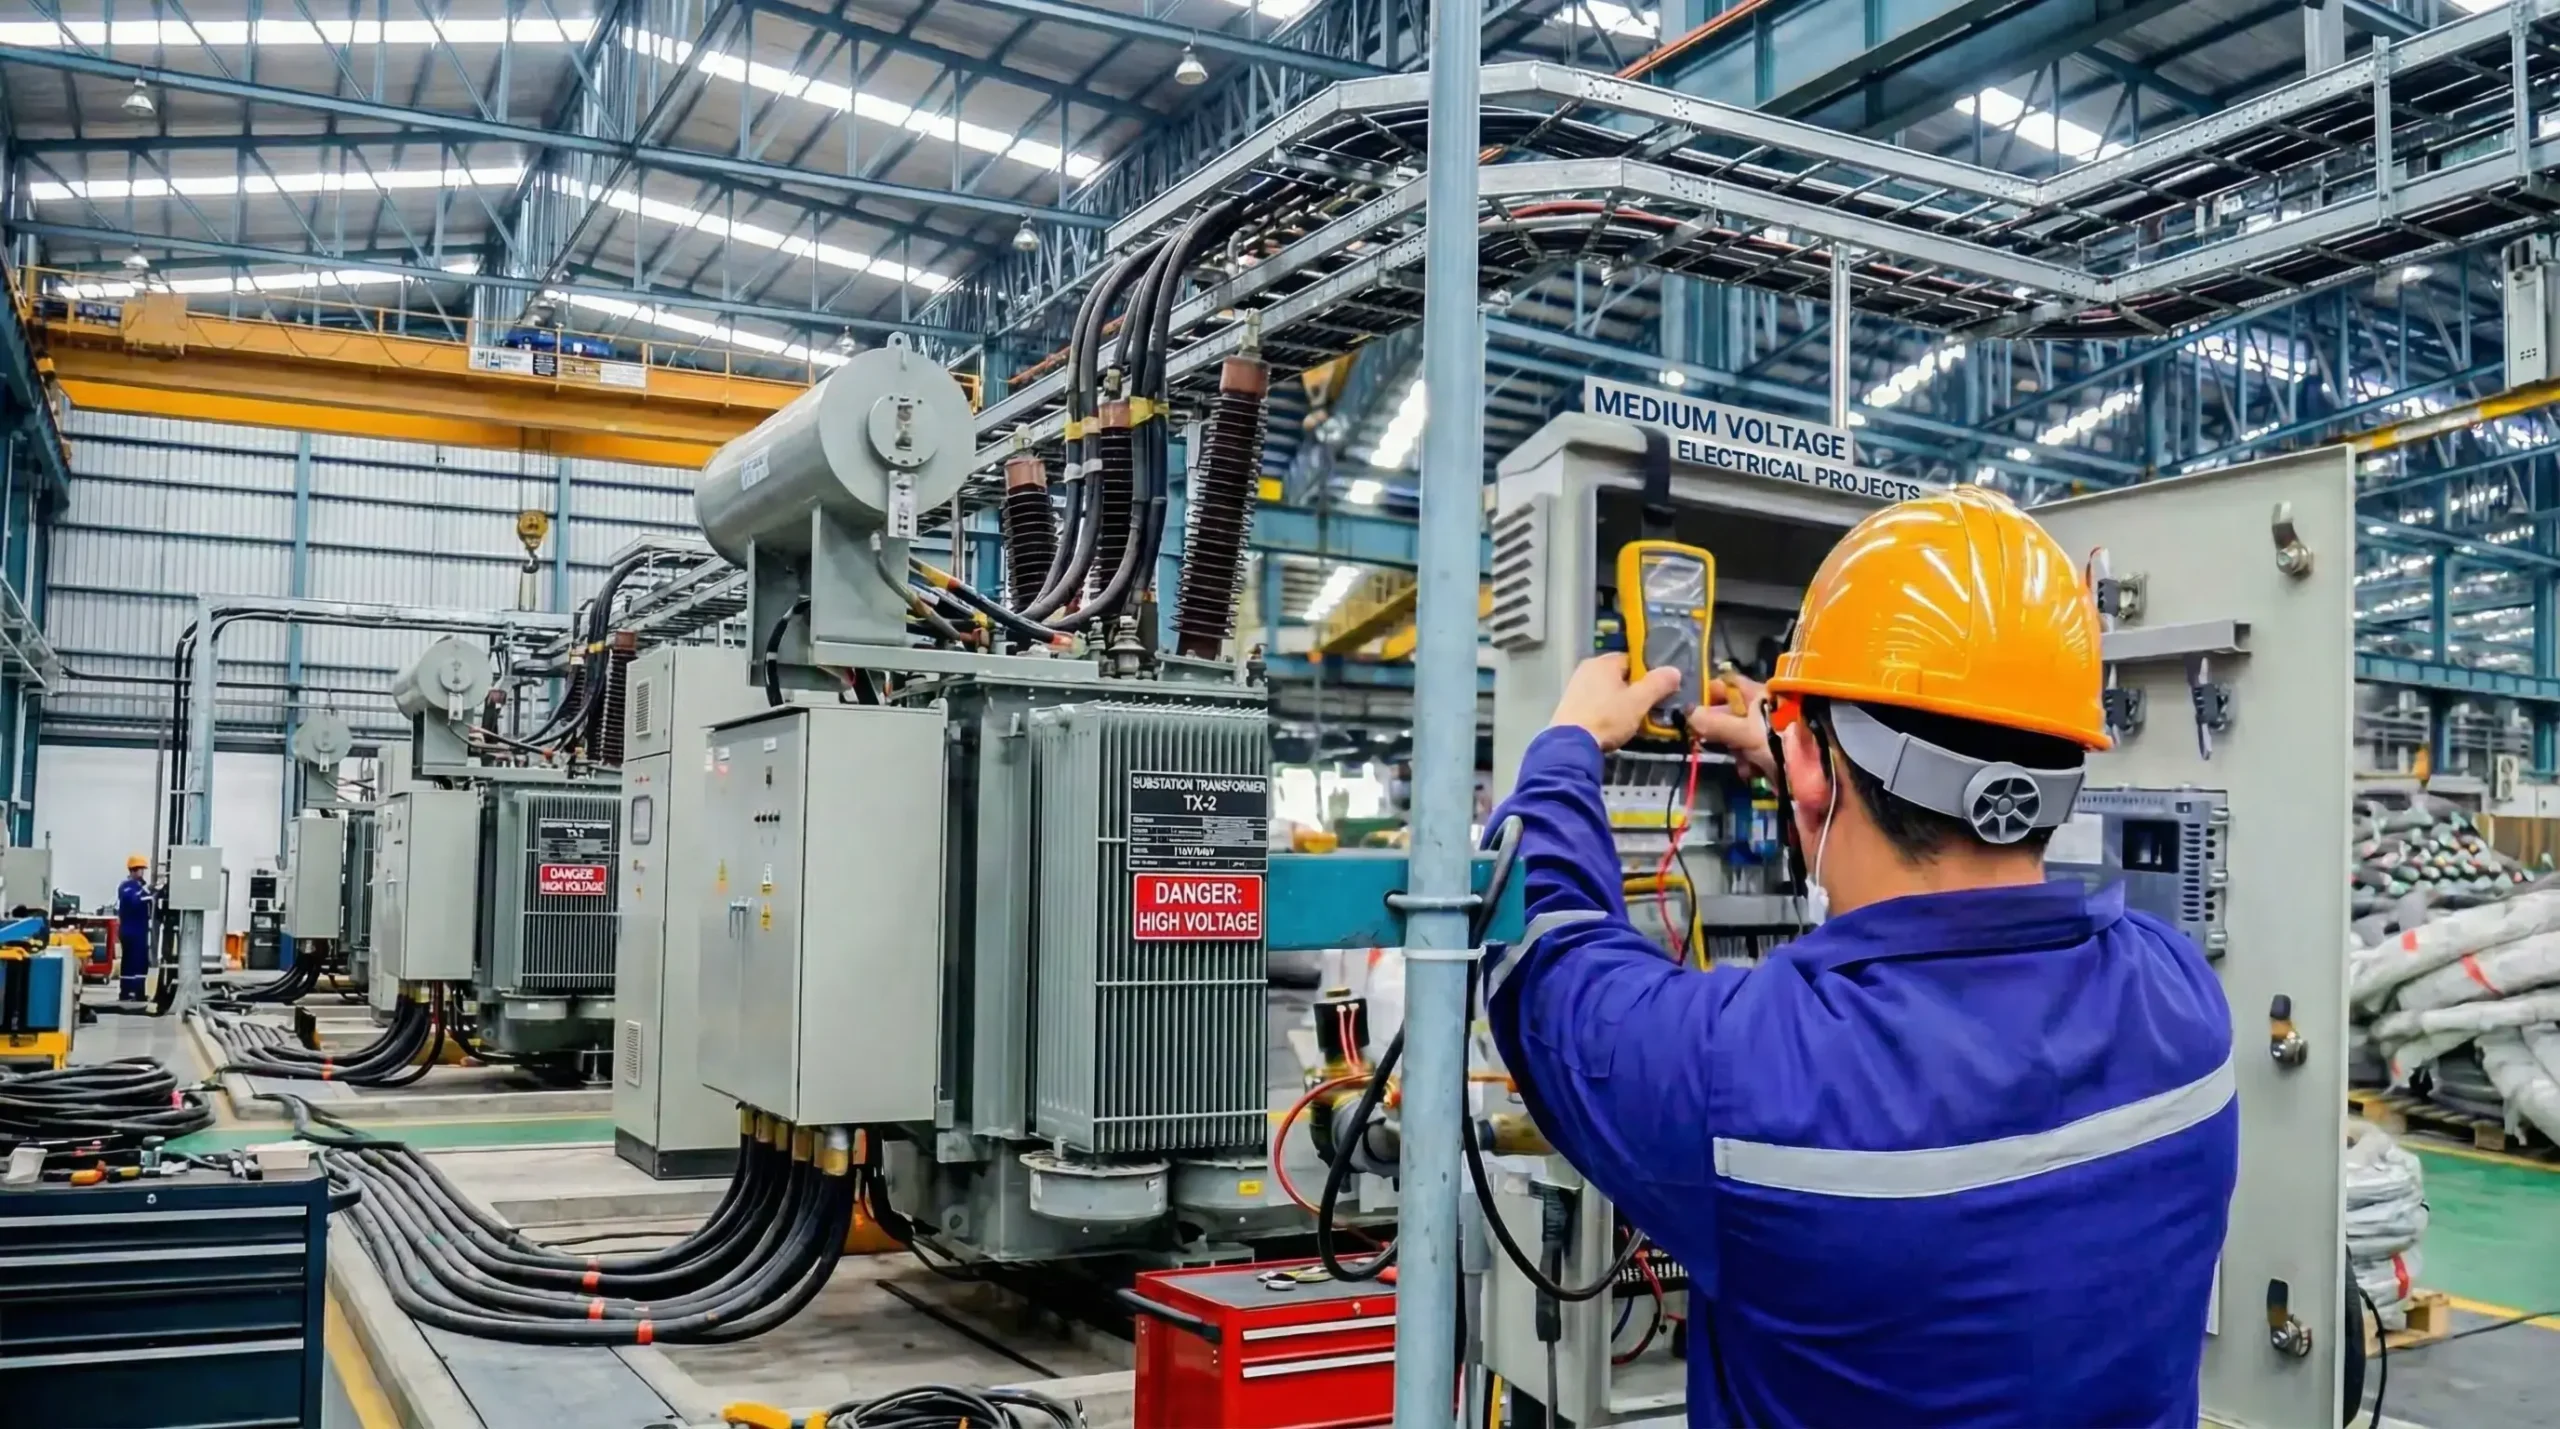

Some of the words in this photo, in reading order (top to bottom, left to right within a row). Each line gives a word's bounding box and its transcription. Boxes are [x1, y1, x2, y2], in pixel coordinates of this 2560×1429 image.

[1594, 386, 1717, 435] MEDIUM
[1725, 413, 1846, 461] VOLTAGE
[1677, 439, 1810, 484] ELECTRICAL
[1815, 467, 1921, 500] PROJECTS
[1132, 776, 1193, 791] SUBSTATION
[1195, 779, 1266, 794] TRANSFORMER
[1183, 794, 1217, 811] TX-2
[1155, 881, 1242, 904] DANGER:
[1139, 911, 1180, 931] HIGH
[1184, 912, 1258, 931] VOLTAGE
